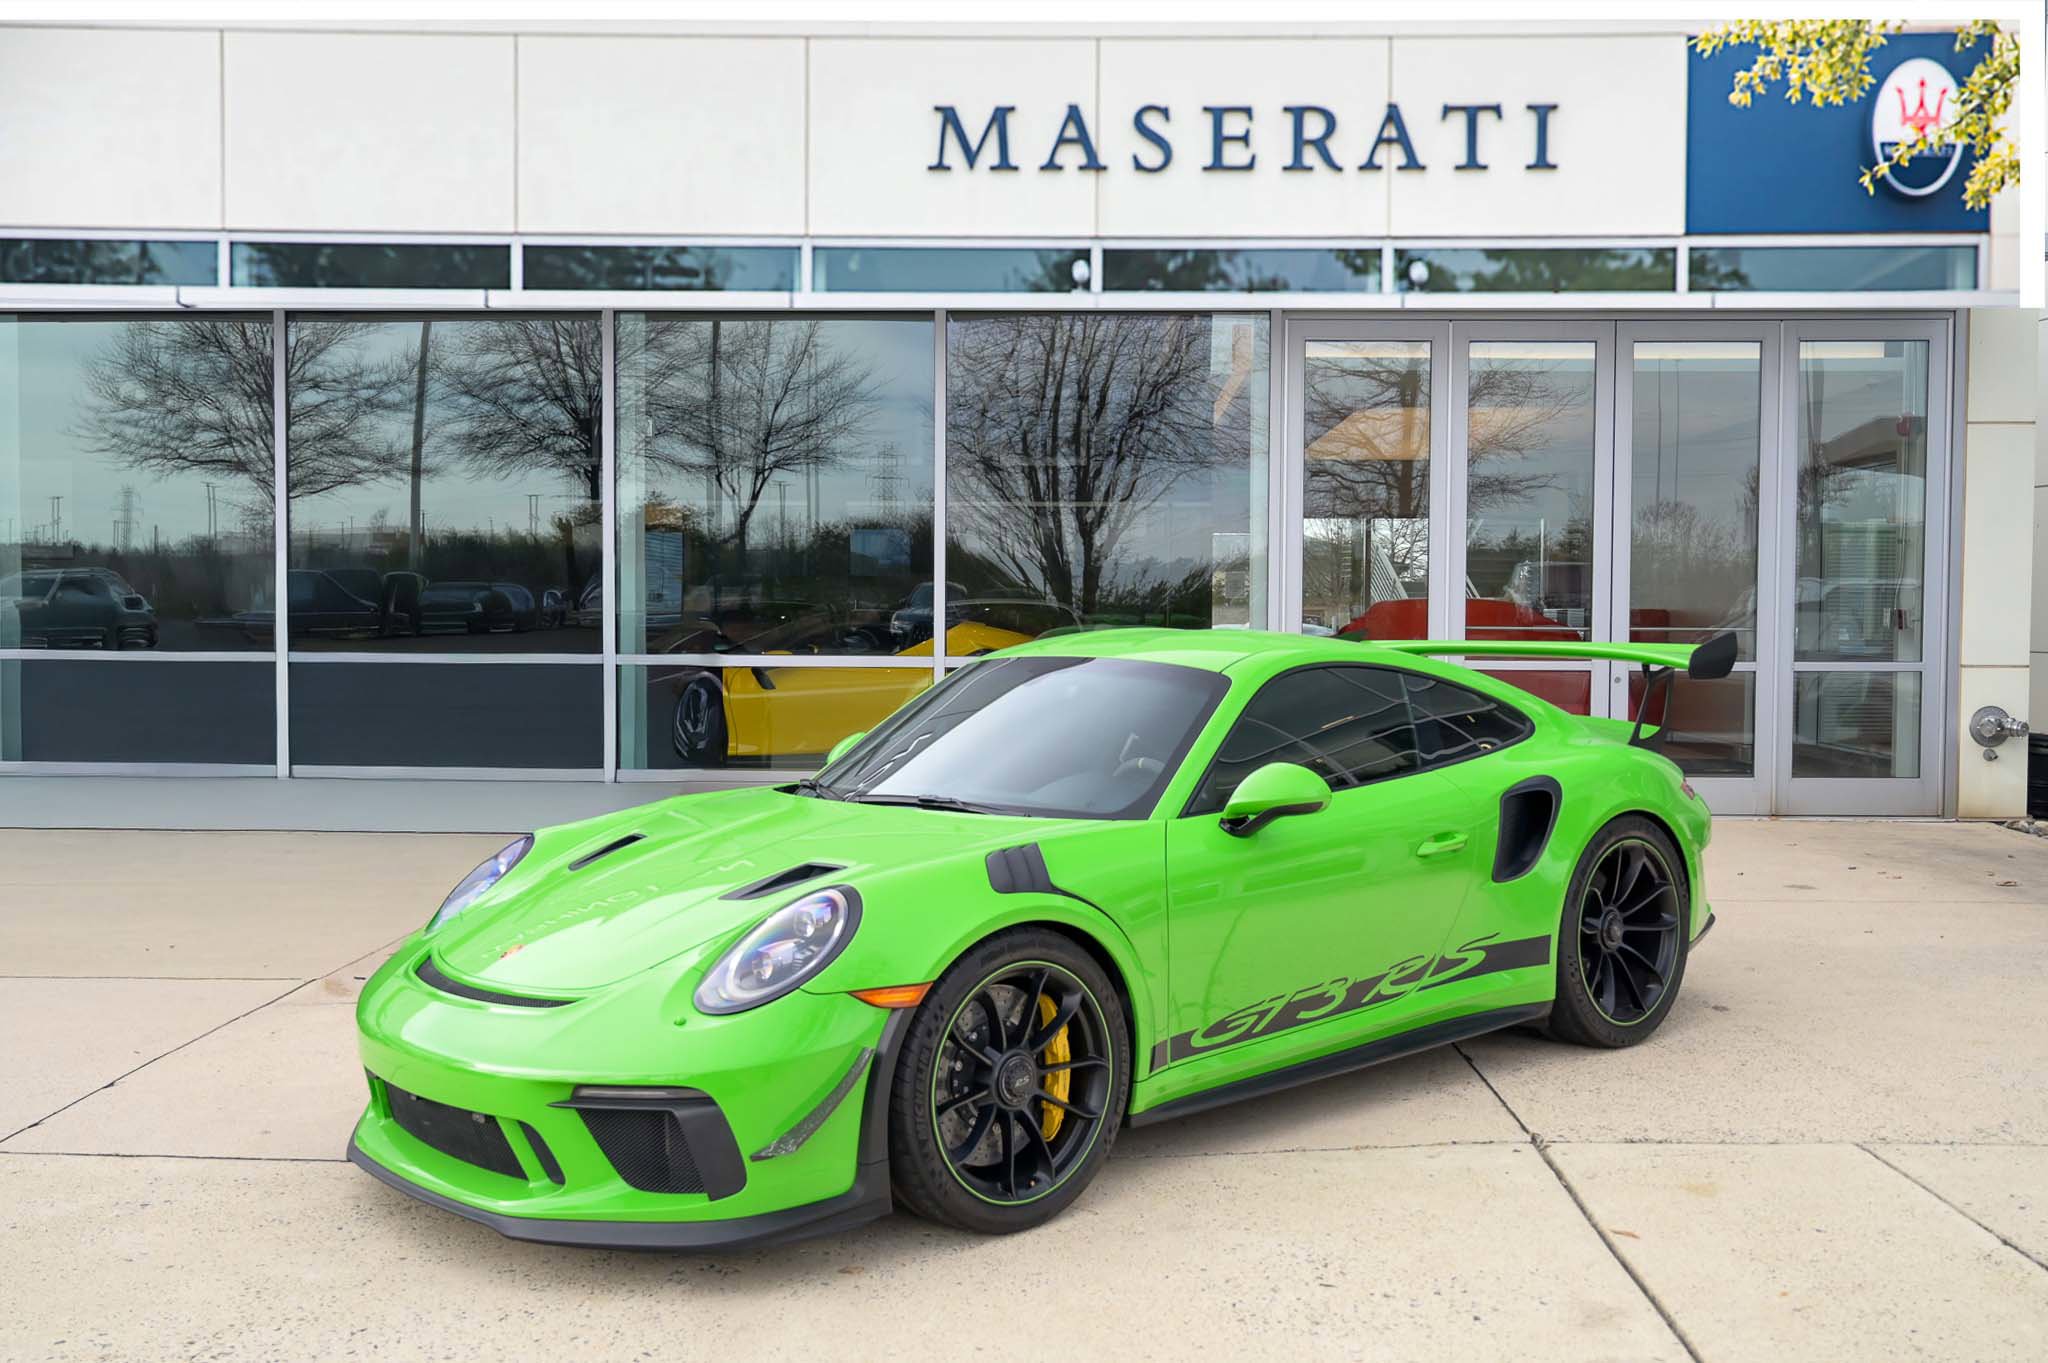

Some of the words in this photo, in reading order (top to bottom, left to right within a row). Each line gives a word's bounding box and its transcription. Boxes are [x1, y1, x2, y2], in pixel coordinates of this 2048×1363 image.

[927, 102, 1559, 172] MASERATI
[1189, 975, 1358, 1048] GT3
[1360, 931, 1501, 1004] RS
